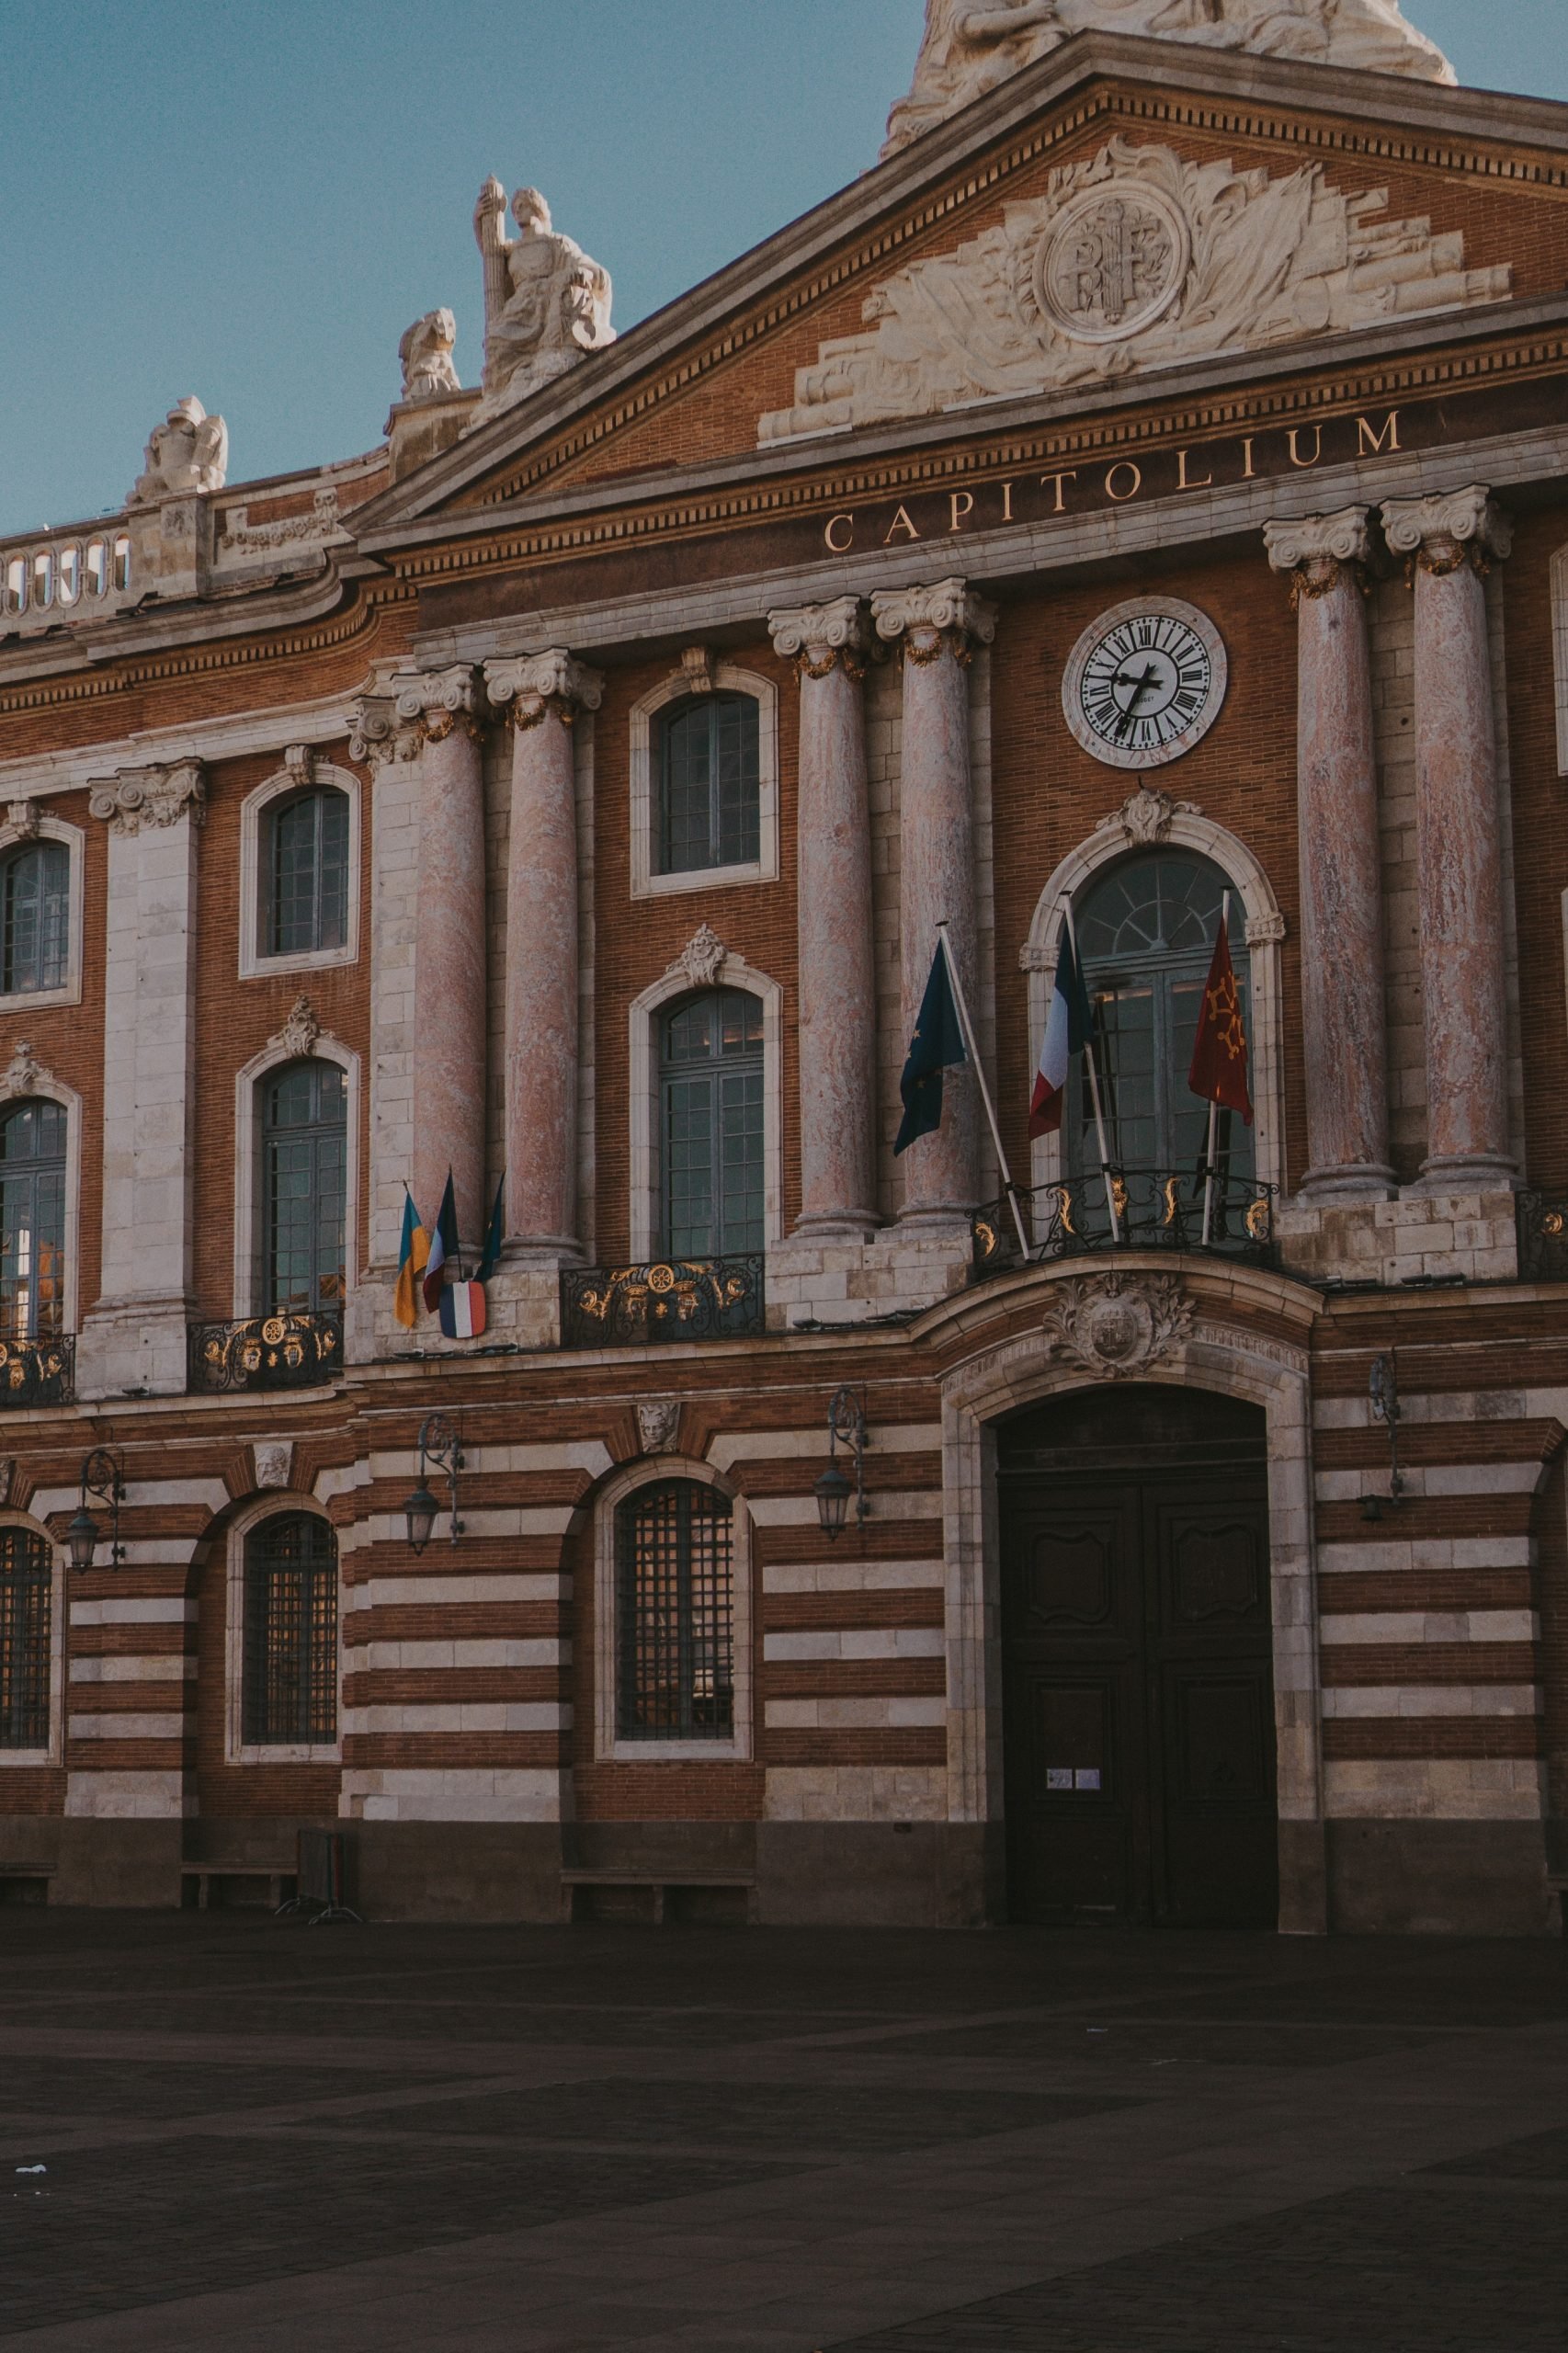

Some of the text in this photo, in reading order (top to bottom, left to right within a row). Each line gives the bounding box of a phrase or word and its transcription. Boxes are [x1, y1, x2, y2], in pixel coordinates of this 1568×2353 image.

[824, 409, 1402, 551] CAPITOLIUM
[1113, 635, 1131, 657] XI
[1139, 625, 1152, 648] XII
[1176, 644, 1195, 662] II
[1096, 659, 1116, 672] X
[1181, 669, 1202, 683] III
